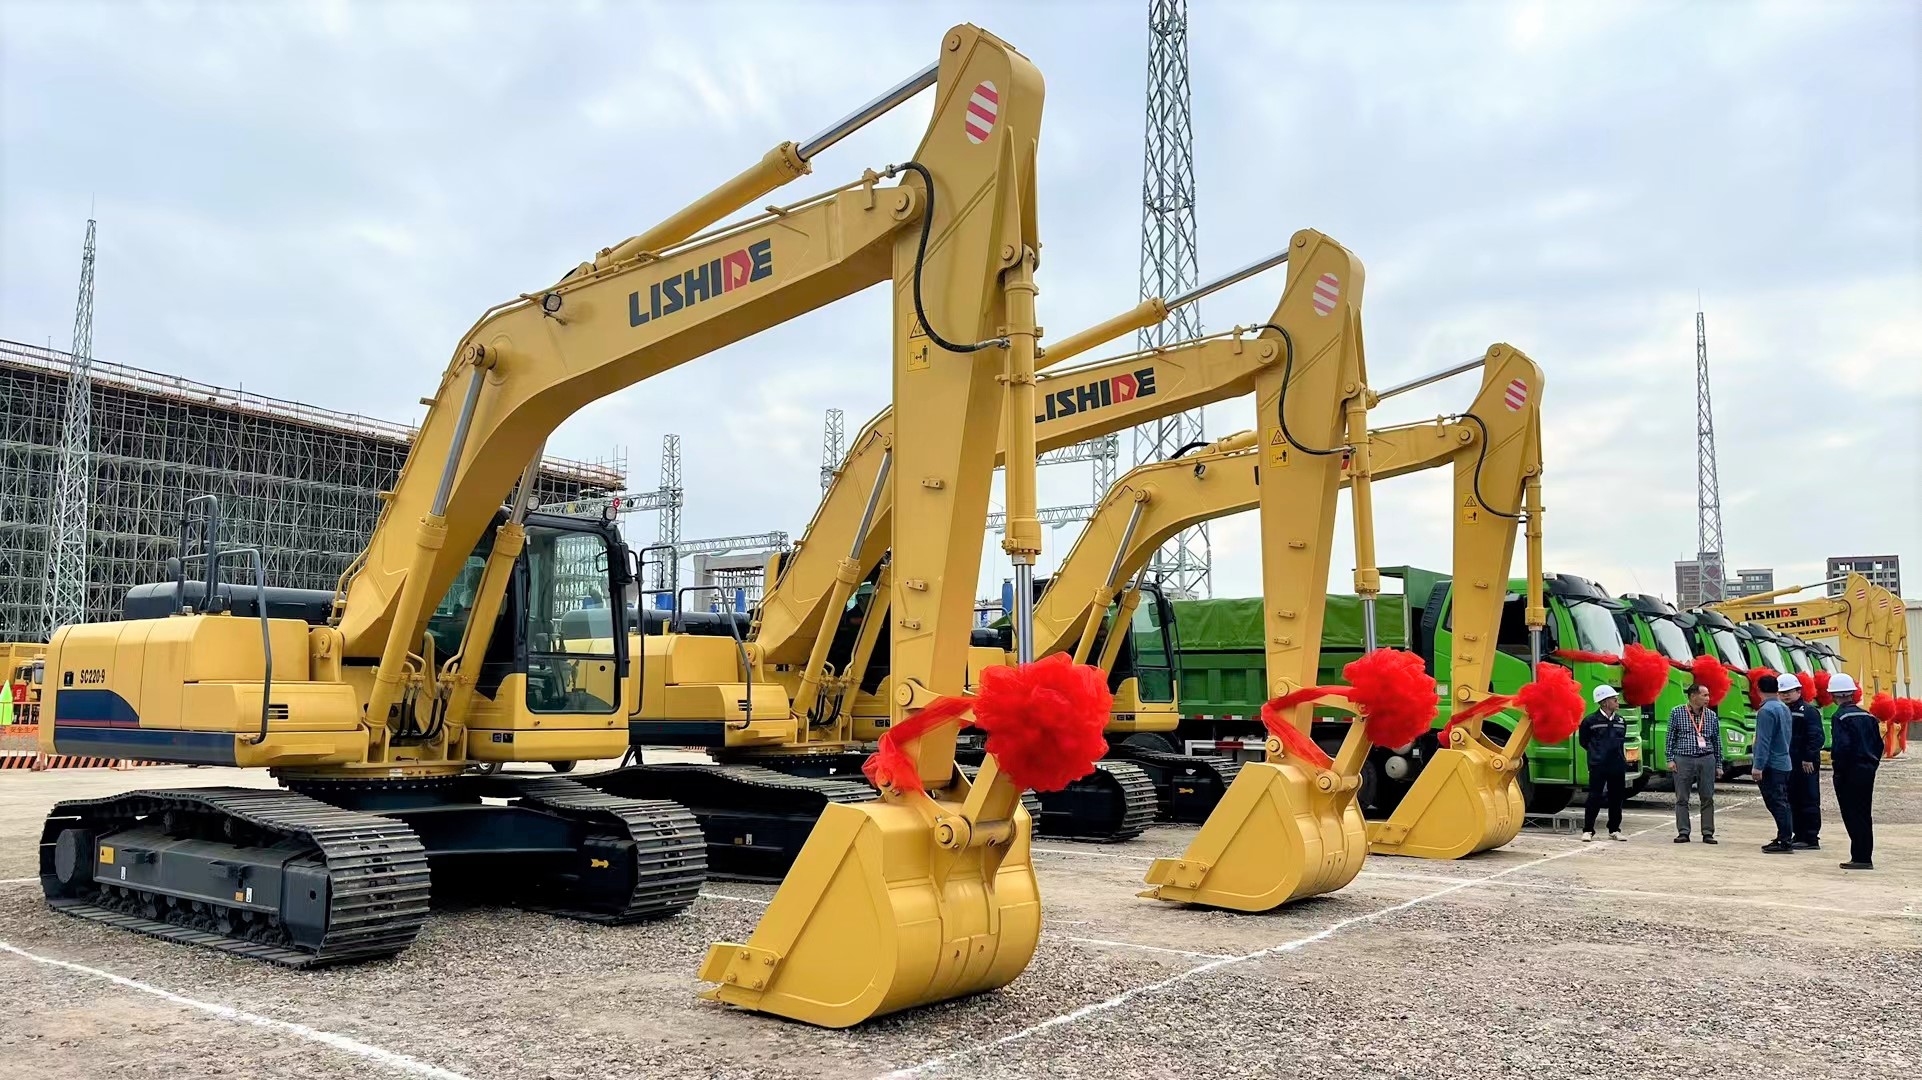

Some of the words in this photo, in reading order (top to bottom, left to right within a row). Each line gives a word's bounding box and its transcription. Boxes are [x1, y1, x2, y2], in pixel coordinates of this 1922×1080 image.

[629, 238, 772, 327] LISHIDE
[1745, 608, 1798, 621] LISHIDE
[80, 668, 106, 684] SC220-9
